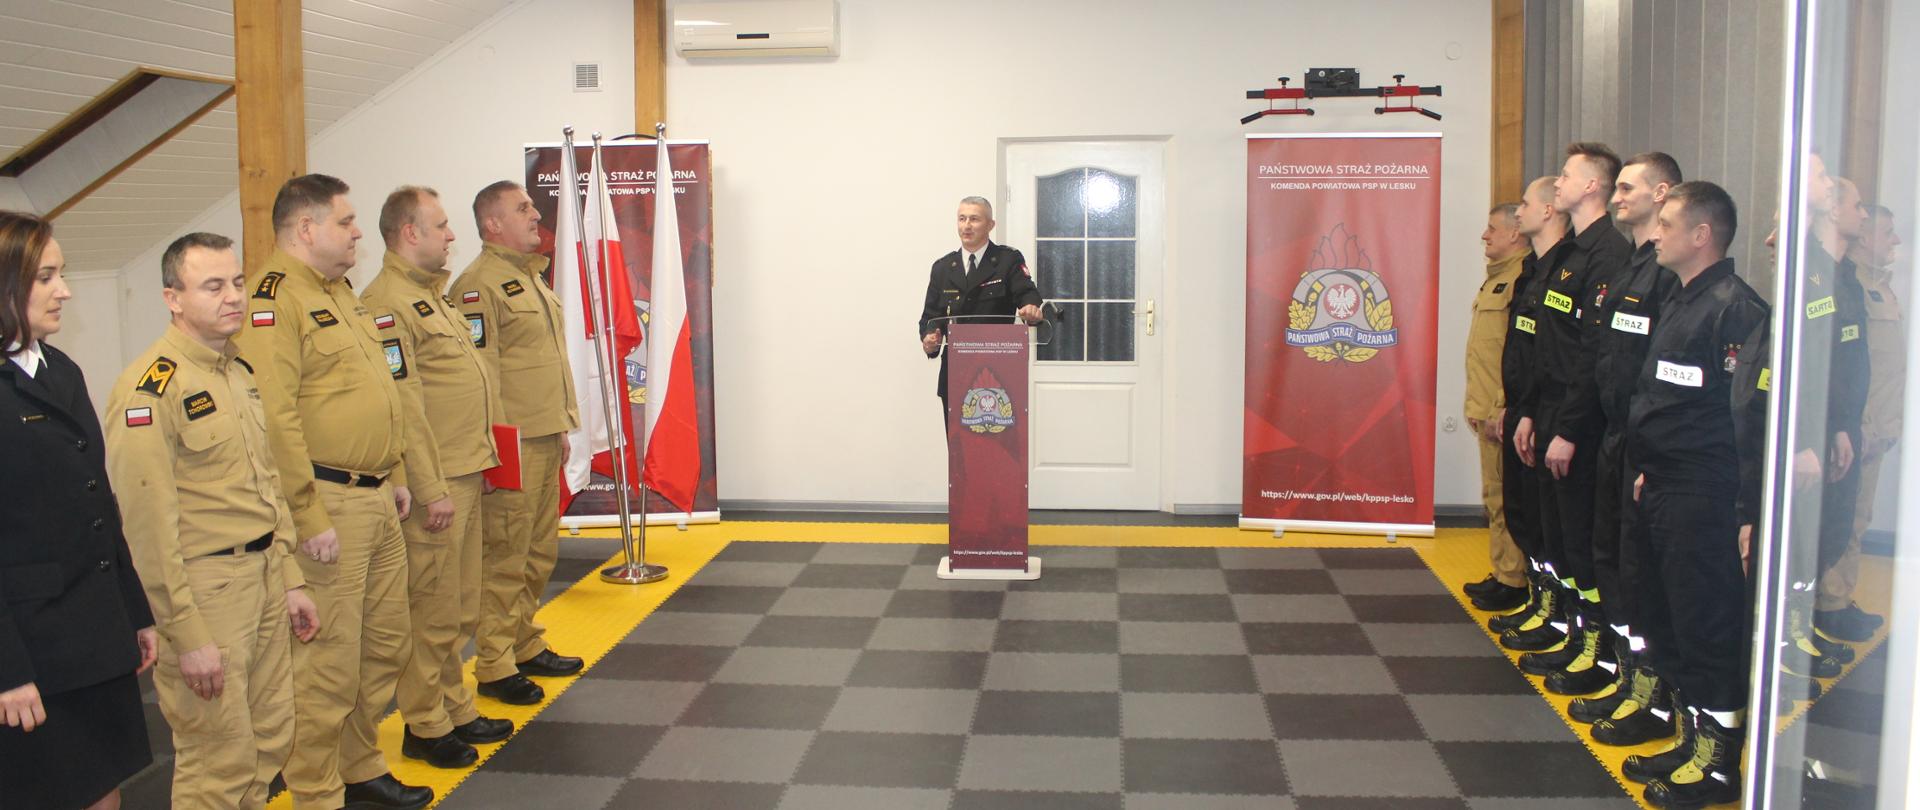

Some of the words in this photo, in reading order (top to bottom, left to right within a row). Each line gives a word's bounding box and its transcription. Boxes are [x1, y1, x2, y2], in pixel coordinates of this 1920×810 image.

[1259, 162, 1333, 174] PAŃSTWOWA
[1336, 162, 1372, 174] STRAŻ
[1374, 162, 1428, 174] POŻARNA
[610, 169, 644, 181] STRAŻ
[635, 187, 651, 195] PSP
[1270, 182, 1310, 190] KOMENDA
[1312, 182, 1360, 190] POWIATOWA
[1362, 182, 1378, 190] PSP
[1379, 182, 1388, 190] W
[1389, 182, 1416, 190] LESKU
[1287, 330, 1331, 344] PAŃSTWOWA
[1332, 325, 1354, 338] STRAŻ
[1357, 331, 1395, 345] POŻARNA
[1261, 490, 1415, 504] https://www.gov.pl/web/kppsp-lesko
